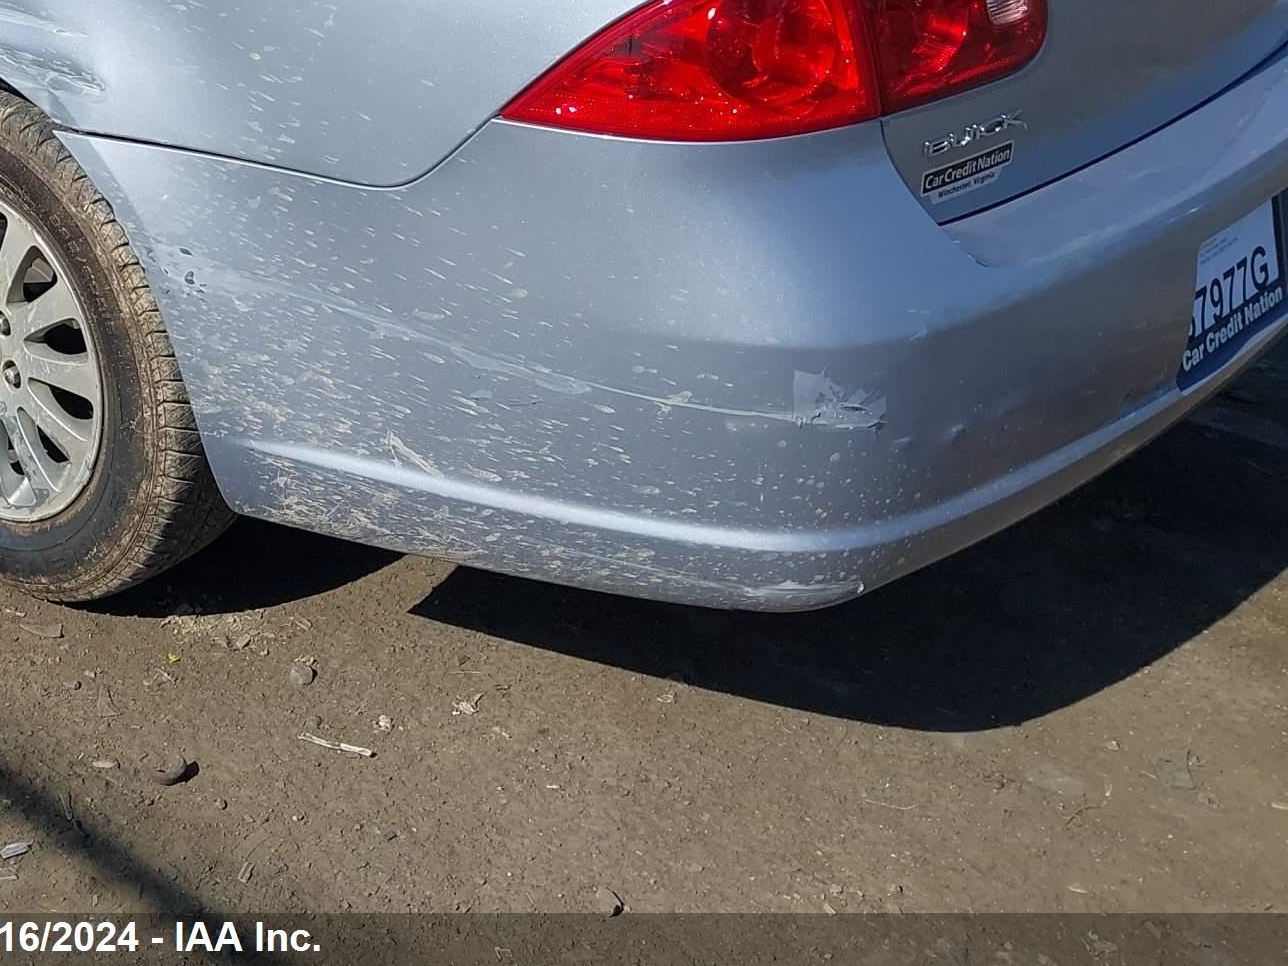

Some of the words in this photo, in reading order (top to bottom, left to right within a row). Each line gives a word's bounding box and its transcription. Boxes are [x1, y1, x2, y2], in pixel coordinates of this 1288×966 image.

[923, 108, 1028, 158] BUICK
[977, 149, 1010, 171] Nation
[1182, 342, 1205, 372] Car
[1206, 313, 1244, 353] Credit
[1244, 286, 1283, 326] Nation
